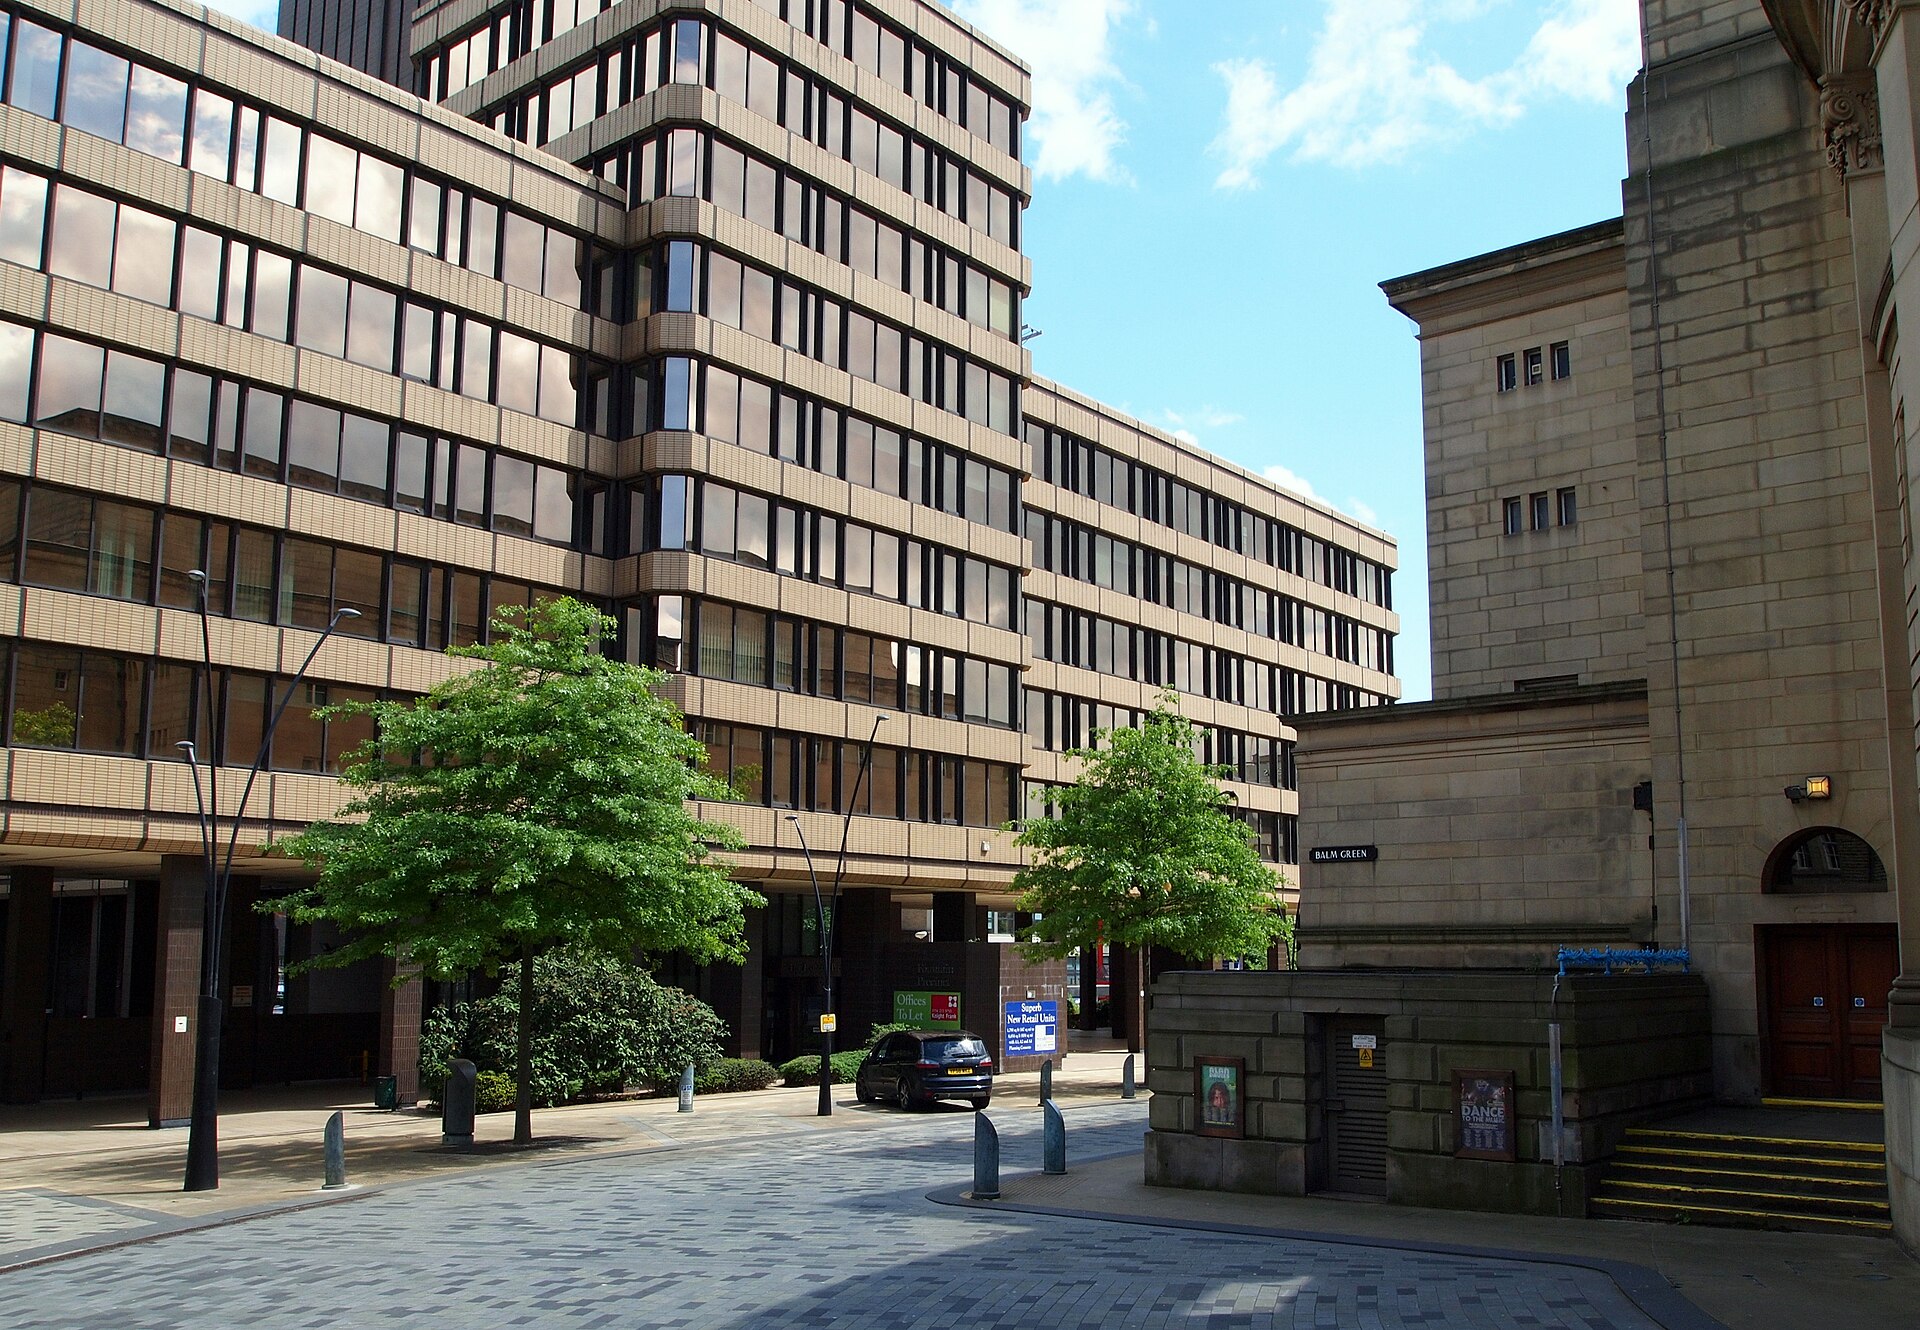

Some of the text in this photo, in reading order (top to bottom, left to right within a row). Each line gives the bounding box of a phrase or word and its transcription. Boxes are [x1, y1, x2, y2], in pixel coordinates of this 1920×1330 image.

[1315, 849, 1367, 860] BALM GREEN
[897, 994, 927, 1006] Offices
[1021, 1002, 1042, 1013] Superb
[897, 1008, 907, 1020] To
[909, 1008, 923, 1020] Let
[1007, 1013, 1056, 1024] New Retail Units
[1461, 1105, 1504, 1118] DANCE
[1485, 1116, 1504, 1124] MUSIC
